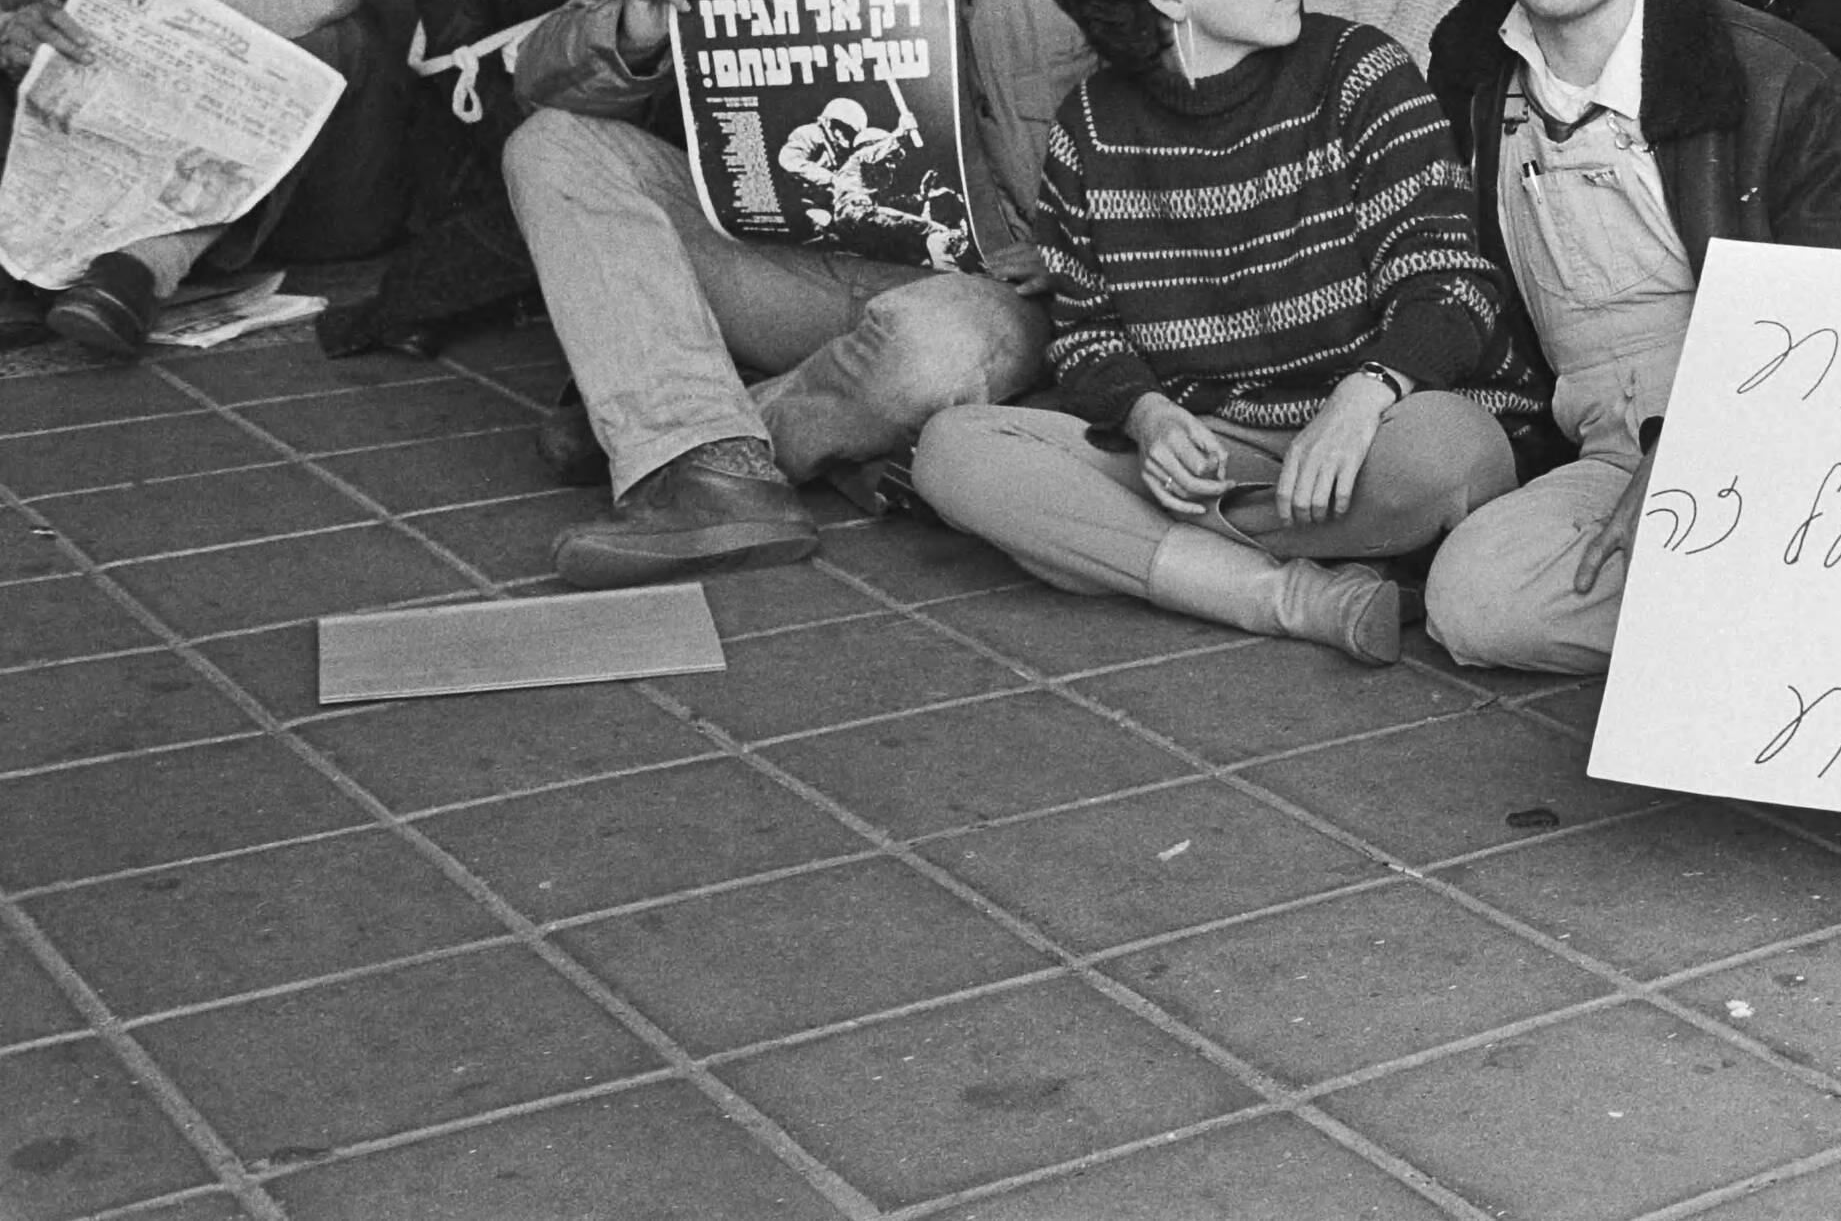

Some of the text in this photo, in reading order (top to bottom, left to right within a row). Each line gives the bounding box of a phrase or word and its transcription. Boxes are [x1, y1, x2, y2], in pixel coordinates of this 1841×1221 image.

[697, 37, 931, 89] שלא ידעתם!
[1646, 474, 1743, 556] זה
